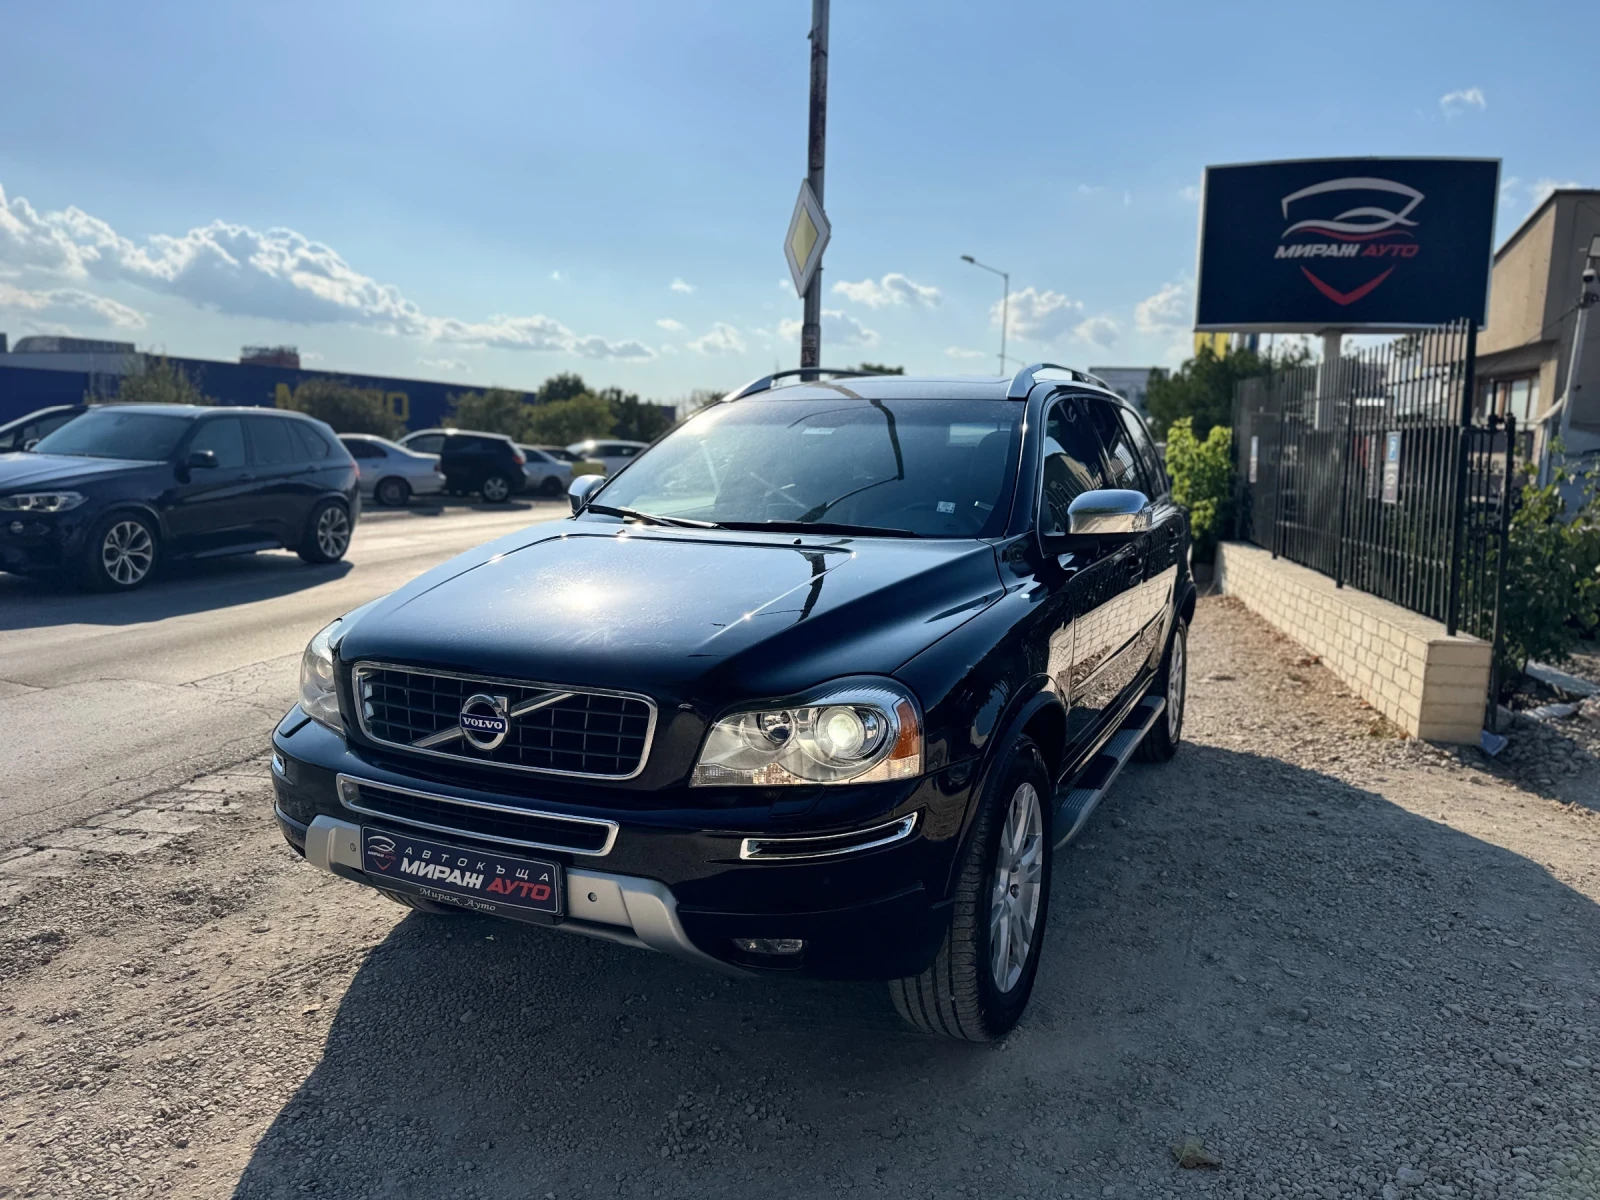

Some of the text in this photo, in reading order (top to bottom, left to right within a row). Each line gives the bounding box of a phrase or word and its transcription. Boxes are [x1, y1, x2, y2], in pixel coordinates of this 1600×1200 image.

[1274, 243, 1420, 259] МИРАЖ АУТО
[462, 716, 503, 730] VOLVO
[404, 846, 549, 882] АВТОКЪЩА
[400, 857, 552, 901] МИРАЖ АУТО
[419, 887, 497, 912] Мираж Ауто
